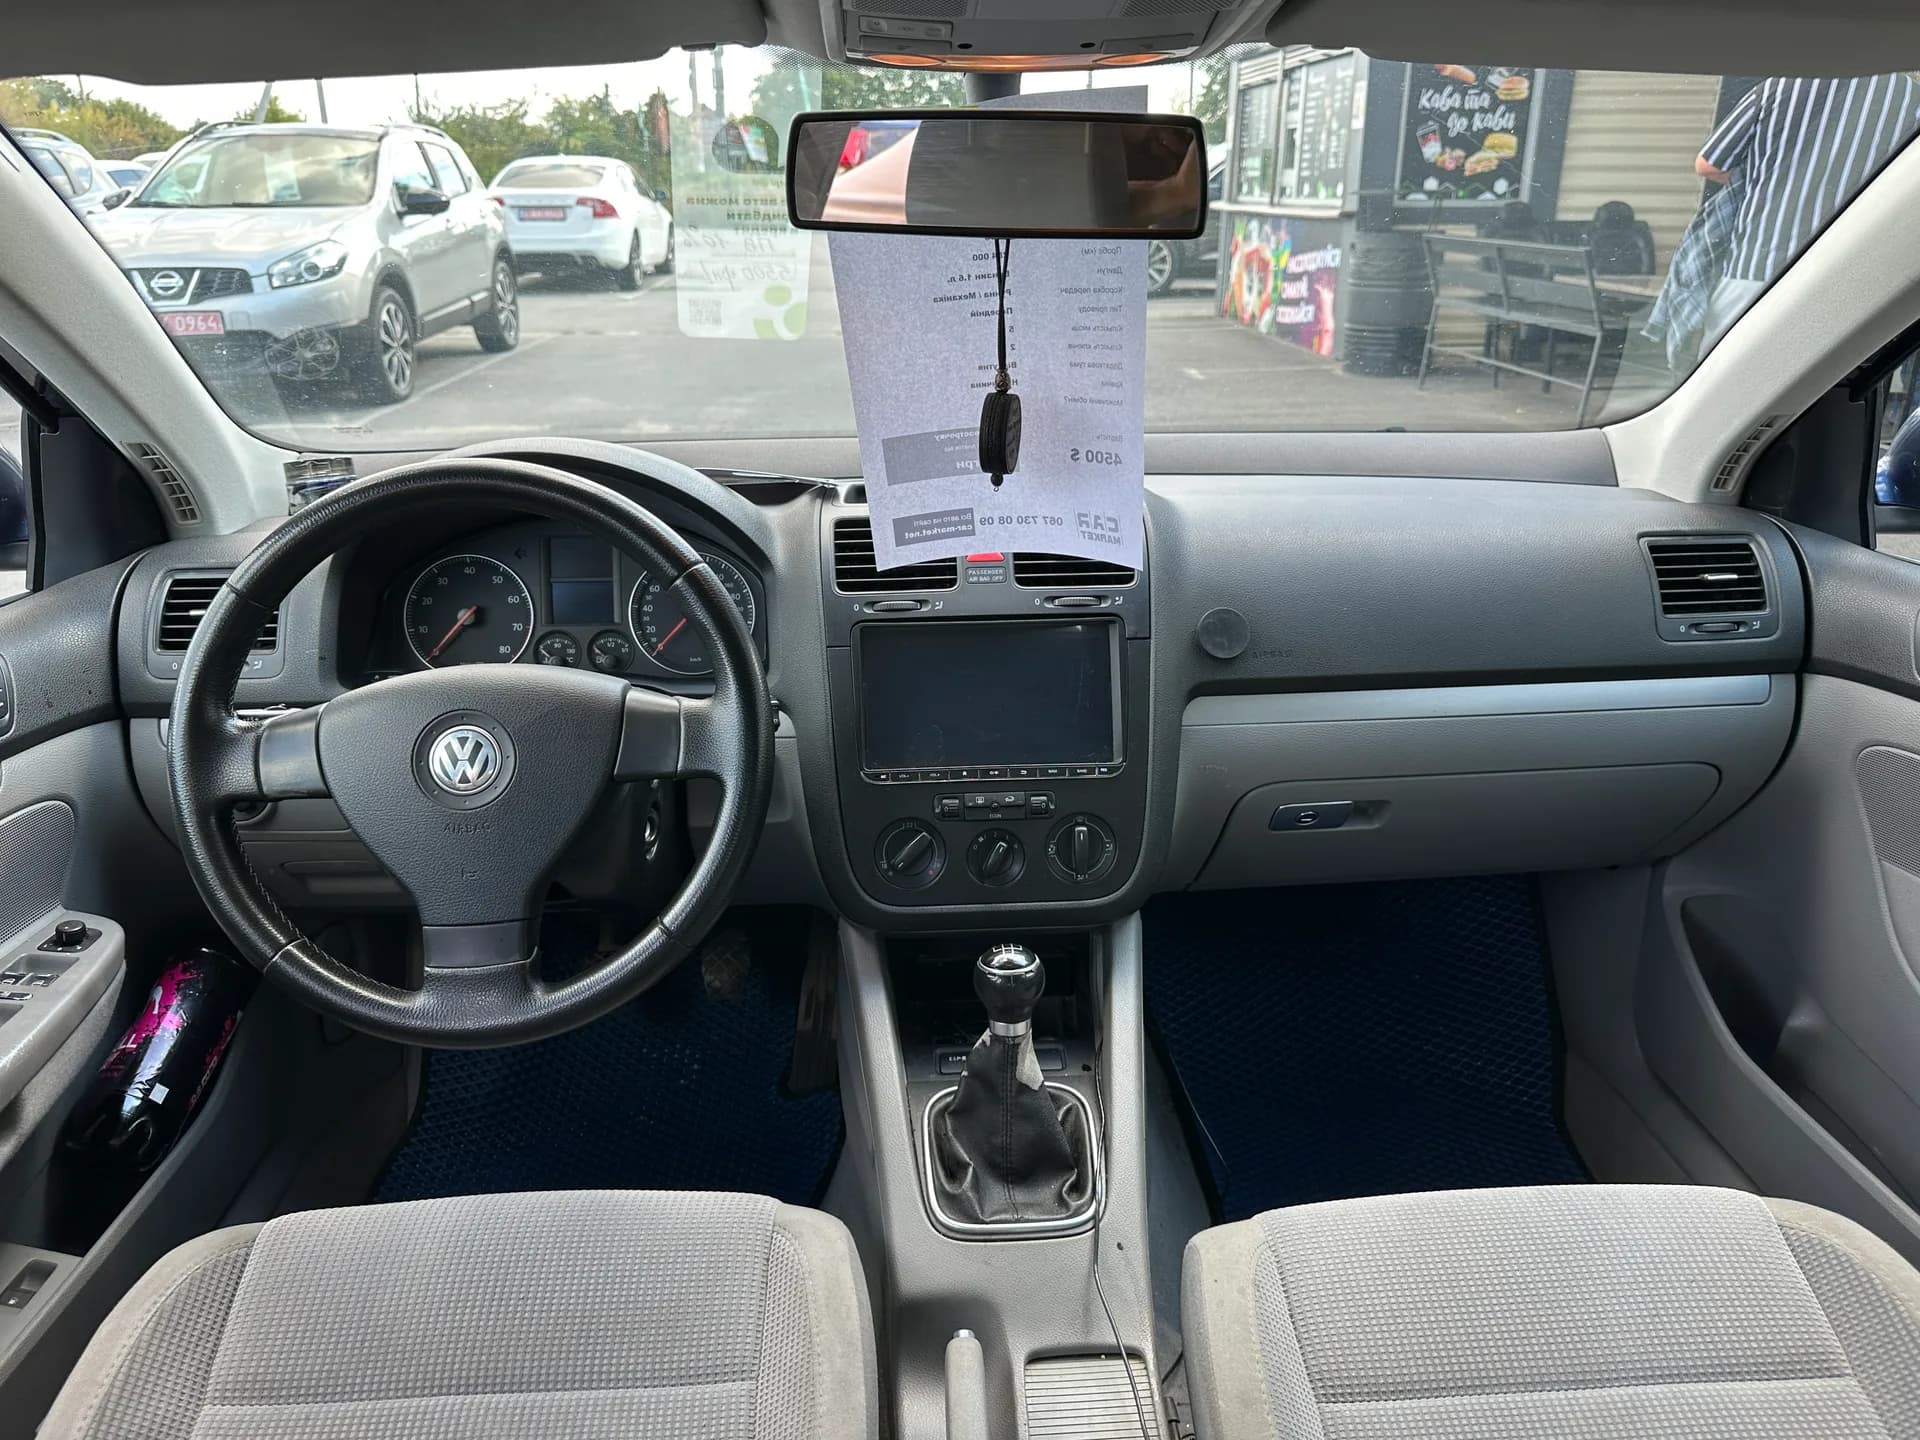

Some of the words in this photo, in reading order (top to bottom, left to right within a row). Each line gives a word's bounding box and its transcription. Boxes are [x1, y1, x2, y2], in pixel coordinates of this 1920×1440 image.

[1418, 85, 1462, 112] Кава
[1464, 89, 1491, 110] та
[1446, 112, 1468, 138] до
[1472, 104, 1516, 132] кави
[464, 566, 476, 574] 40
[438, 577, 448, 585] 30
[492, 576, 504, 584] 50
[650, 585, 660, 594] 60
[422, 596, 432, 605] 20
[507, 595, 520, 604] 60
[642, 604, 654, 612] 40
[418, 626, 429, 634] 10
[512, 623, 523, 632] 70
[646, 625, 656, 634] 20
[498, 645, 511, 654] 80
[172, 662, 178, 670] 0
[444, 822, 492, 834] AIRBAG
